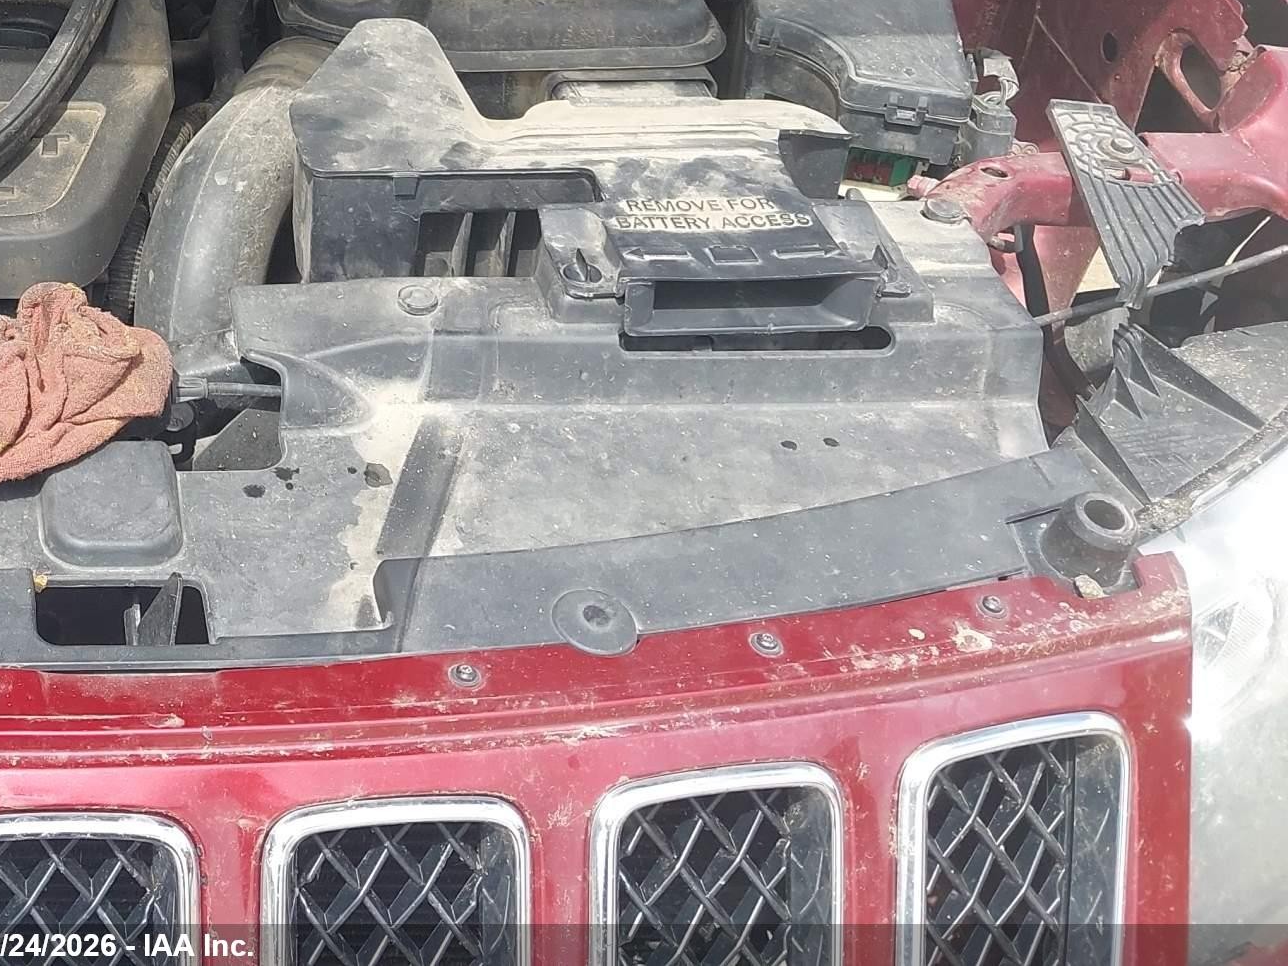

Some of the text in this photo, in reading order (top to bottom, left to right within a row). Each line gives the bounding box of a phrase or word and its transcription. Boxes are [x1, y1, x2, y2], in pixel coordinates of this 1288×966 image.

[625, 196, 775, 212] REMOVE FOR
[615, 213, 811, 229] BATTERY ACCESS
